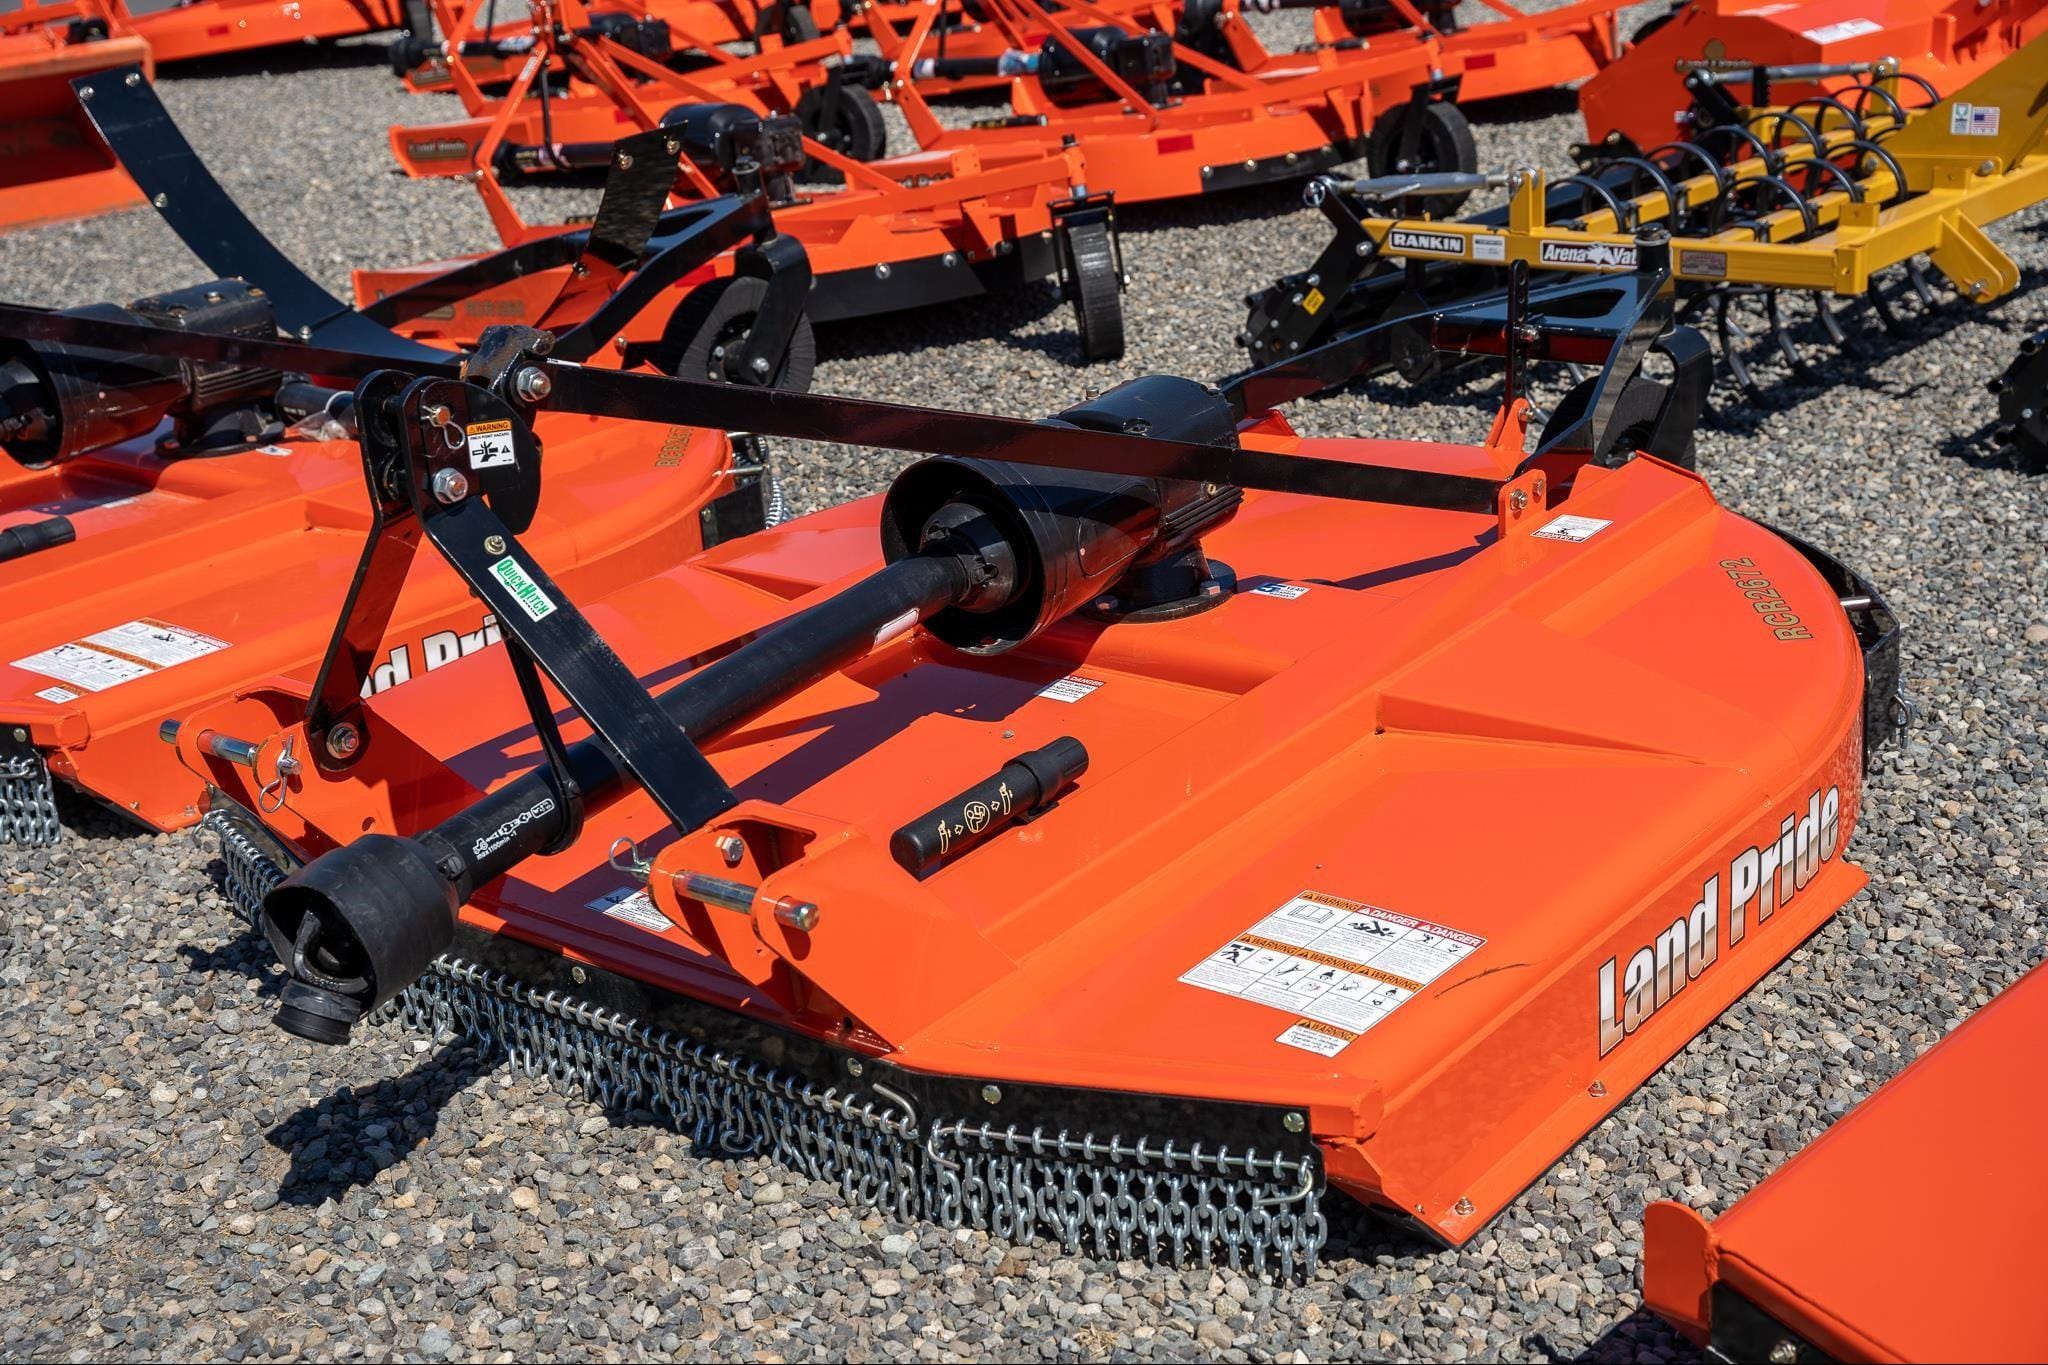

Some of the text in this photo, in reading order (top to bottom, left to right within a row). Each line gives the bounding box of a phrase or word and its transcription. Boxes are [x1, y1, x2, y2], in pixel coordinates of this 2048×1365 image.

[1392, 233, 1461, 252] RANKIN
[1544, 244, 1586, 262] Arena
[476, 421, 508, 432] WARNING
[1719, 557, 1814, 641] RCR2672
[1071, 675, 1104, 687] DANGER
[1314, 895, 1358, 911] WARNING
[1370, 909, 1419, 928] DANGER
[1599, 784, 1839, 1061] Land Pride
[1251, 937, 1297, 954] WARNING
[1430, 925, 1482, 947] DANGER
[1310, 953, 1356, 971] WARNING
[1370, 970, 1419, 990] WARNING
[1311, 1021, 1354, 1042] WARNING
